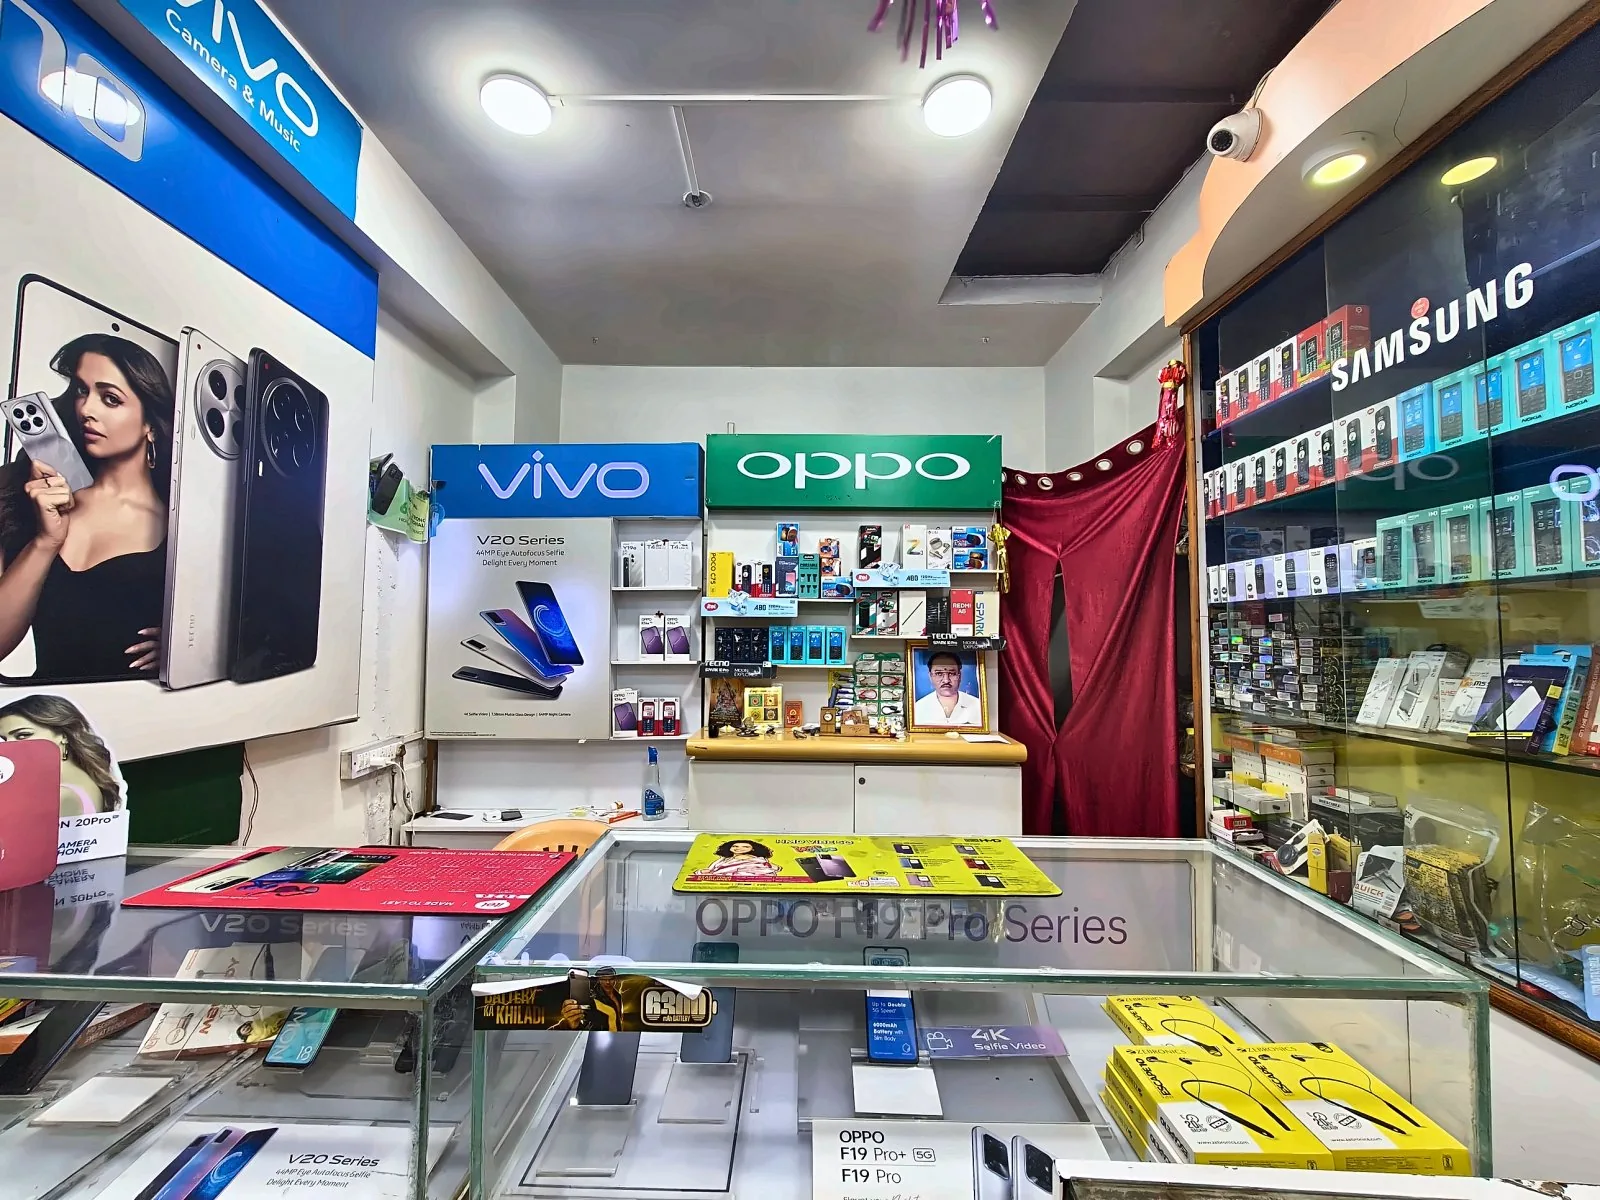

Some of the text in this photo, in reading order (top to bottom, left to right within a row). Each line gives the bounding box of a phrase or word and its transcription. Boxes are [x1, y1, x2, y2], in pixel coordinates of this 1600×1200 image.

[166, 8, 301, 152] Camera & Music
[1331, 262, 1534, 392] SAMSUNG
[1565, 399, 1588, 410] NOKIA
[1521, 415, 1542, 423] NOKIA
[478, 450, 650, 499] vivo
[477, 535, 565, 545] V20 Series
[482, 559, 507, 567] Delight
[975, 602, 985, 636] SPARK
[75, 815, 111, 828] 20Pro
[57, 838, 98, 849] AMERA
[57, 845, 90, 856] HONE
[200, 913, 368, 937] V20 Series
[696, 898, 819, 939] OPPO
[834, 900, 902, 941] F19
[1005, 904, 1128, 945] Series
[484, 1005, 545, 1024] KA KHILADI
[971, 1028, 1011, 1042] 4K
[974, 1042, 1046, 1051] Selfie Video
[839, 1130, 885, 1144] OPPO
[288, 1154, 381, 1167] V20 Series
[840, 1147, 933, 1162] F19 Pro+ 5G
[275, 1168, 371, 1178] 44MP Eye Autofocus Selfie
[841, 1168, 902, 1184] F19 Pro
[266, 1179, 349, 1188] Delight Every Moment
